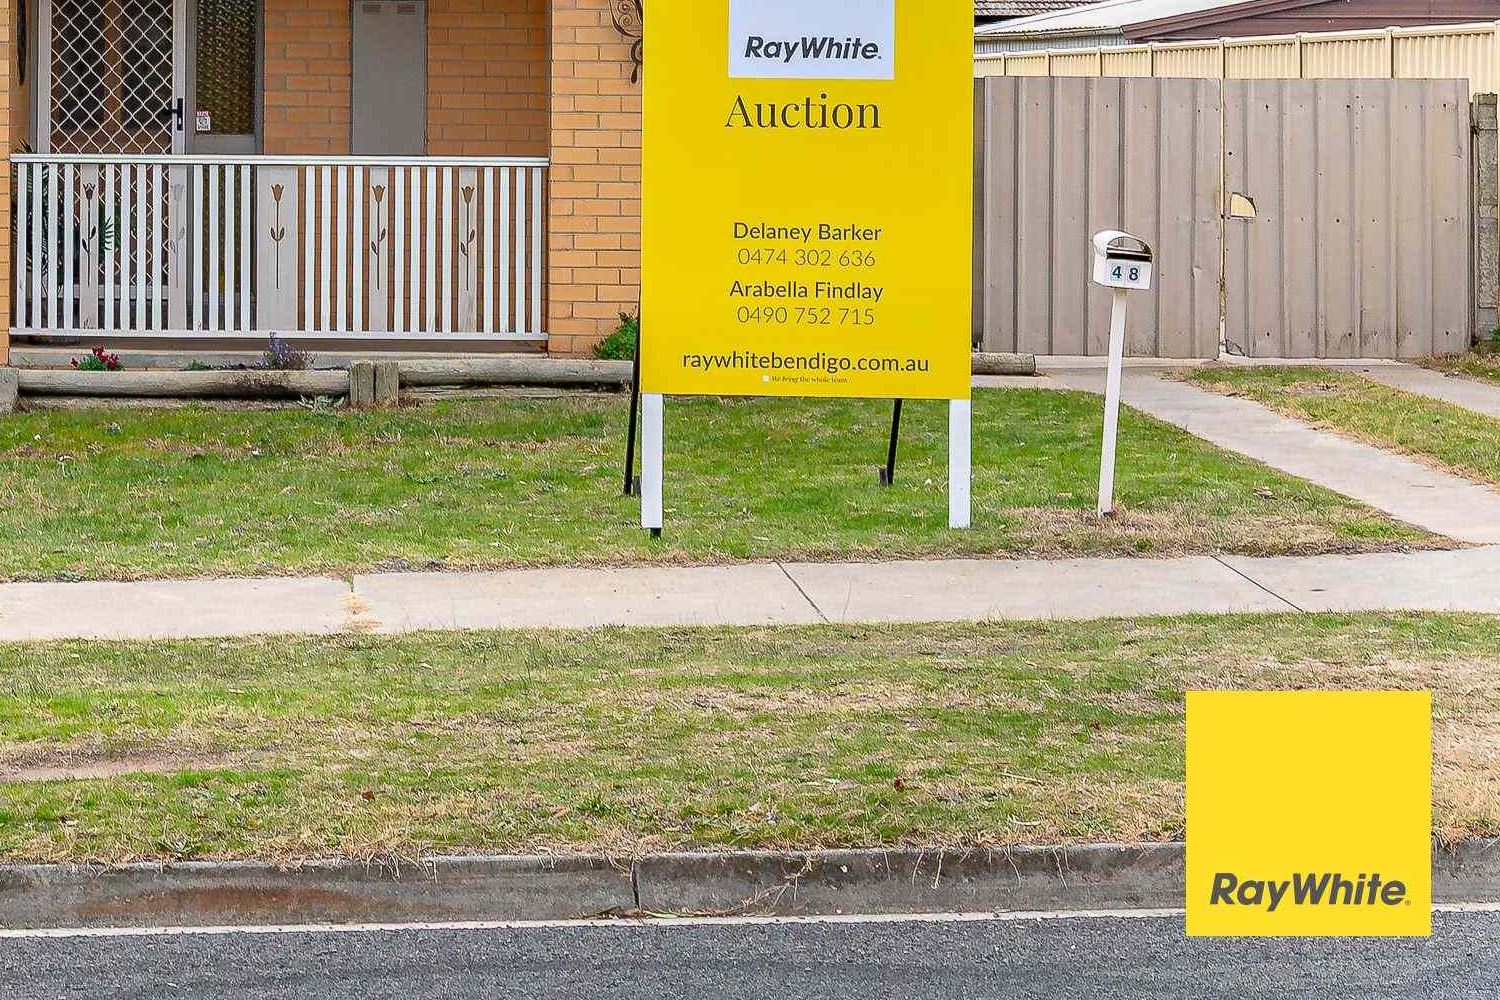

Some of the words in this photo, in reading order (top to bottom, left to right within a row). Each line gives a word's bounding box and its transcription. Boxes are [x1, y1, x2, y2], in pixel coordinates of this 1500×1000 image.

[724, 92, 882, 130] Auction
[732, 222, 812, 244] Delaney
[818, 223, 883, 242] Barker
[736, 248, 788, 266] 0474
[795, 249, 832, 267] 302
[838, 250, 877, 268] 636
[729, 280, 808, 299] Arabella
[815, 281, 885, 303] Findlay
[736, 306, 789, 324] 0490
[795, 307, 831, 325] 752
[839, 308, 875, 326] 715
[683, 351, 930, 374] raywhitebendigo.com.au
